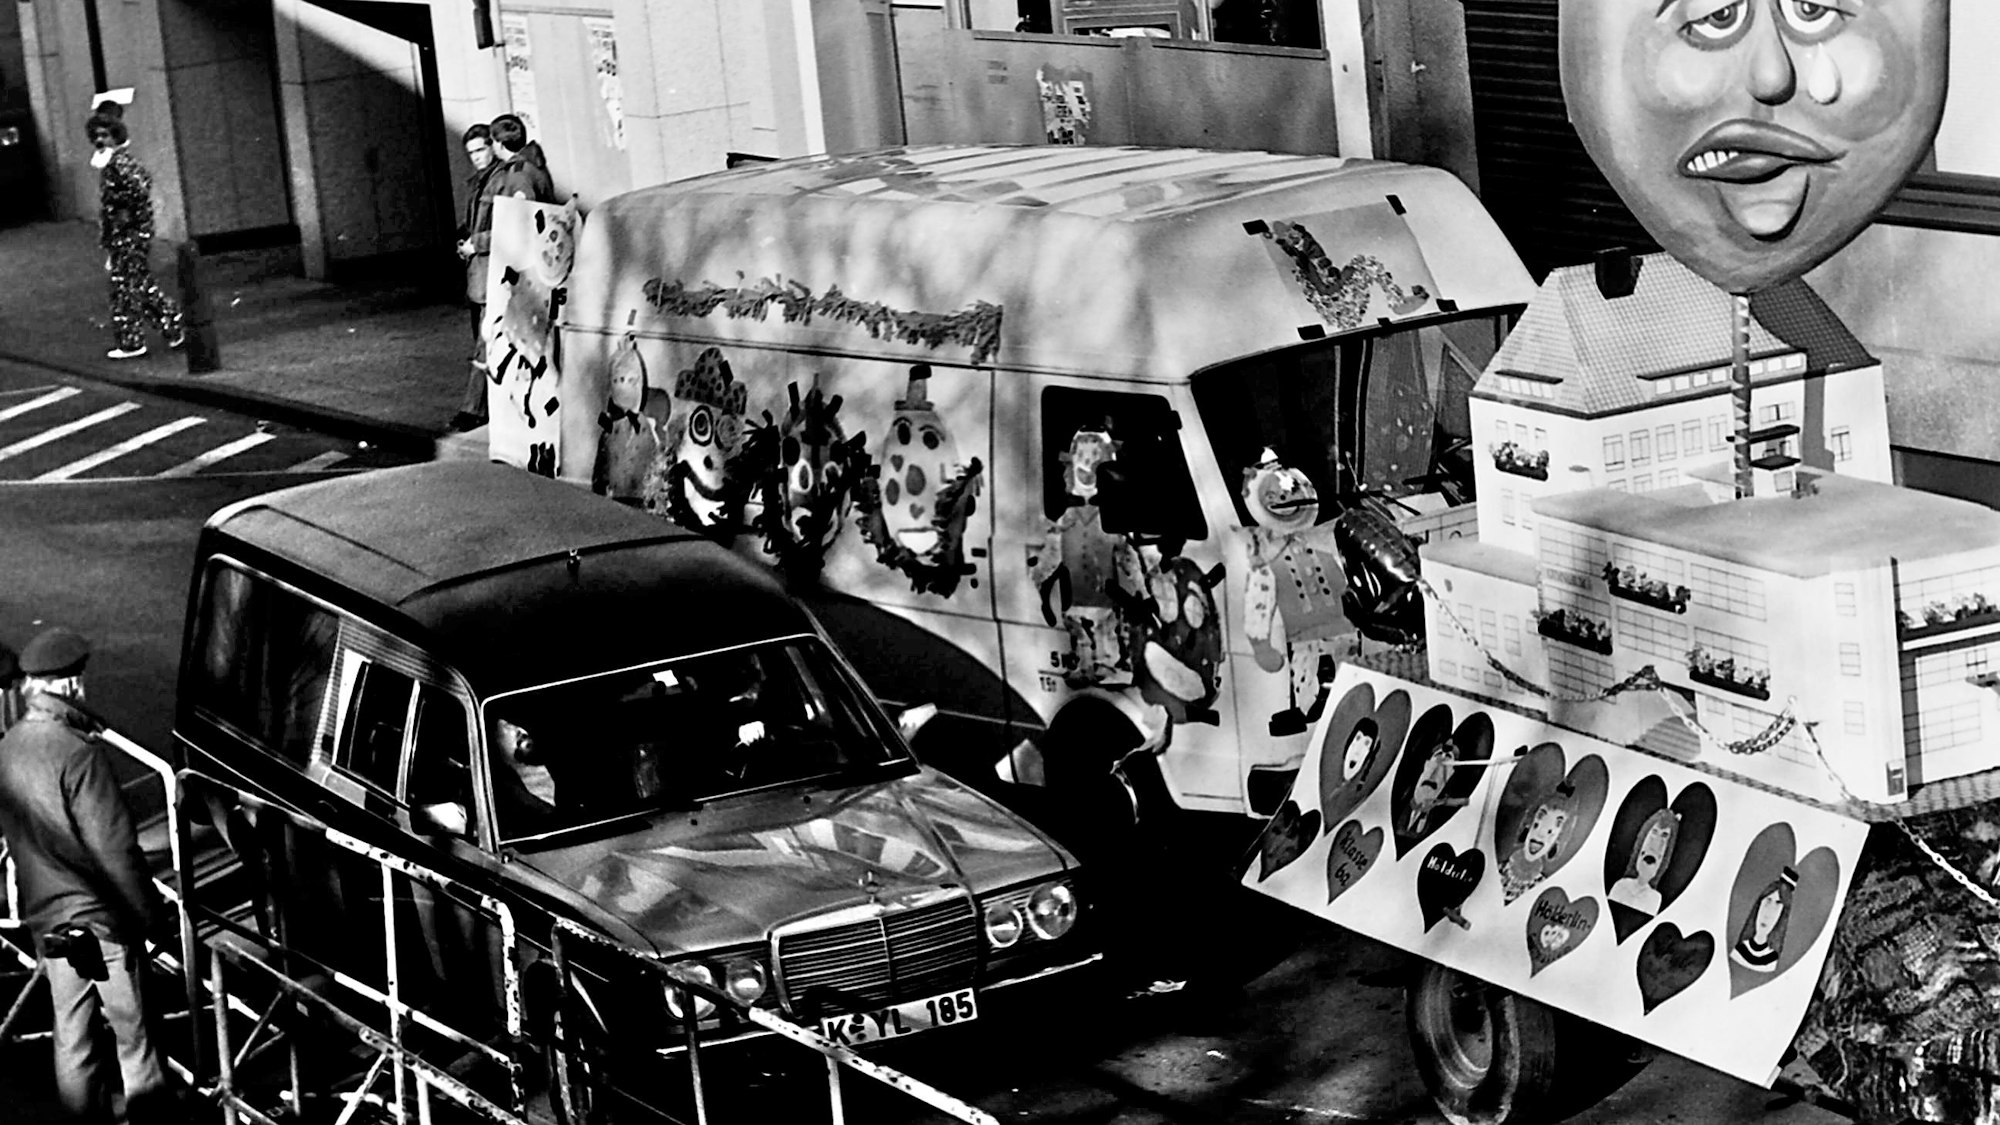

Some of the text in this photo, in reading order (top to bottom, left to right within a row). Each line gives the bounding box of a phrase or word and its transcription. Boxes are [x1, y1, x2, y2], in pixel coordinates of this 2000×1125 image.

[1340, 830, 1369, 871] Klasse
[827, 991, 974, 1046] K YL 185
